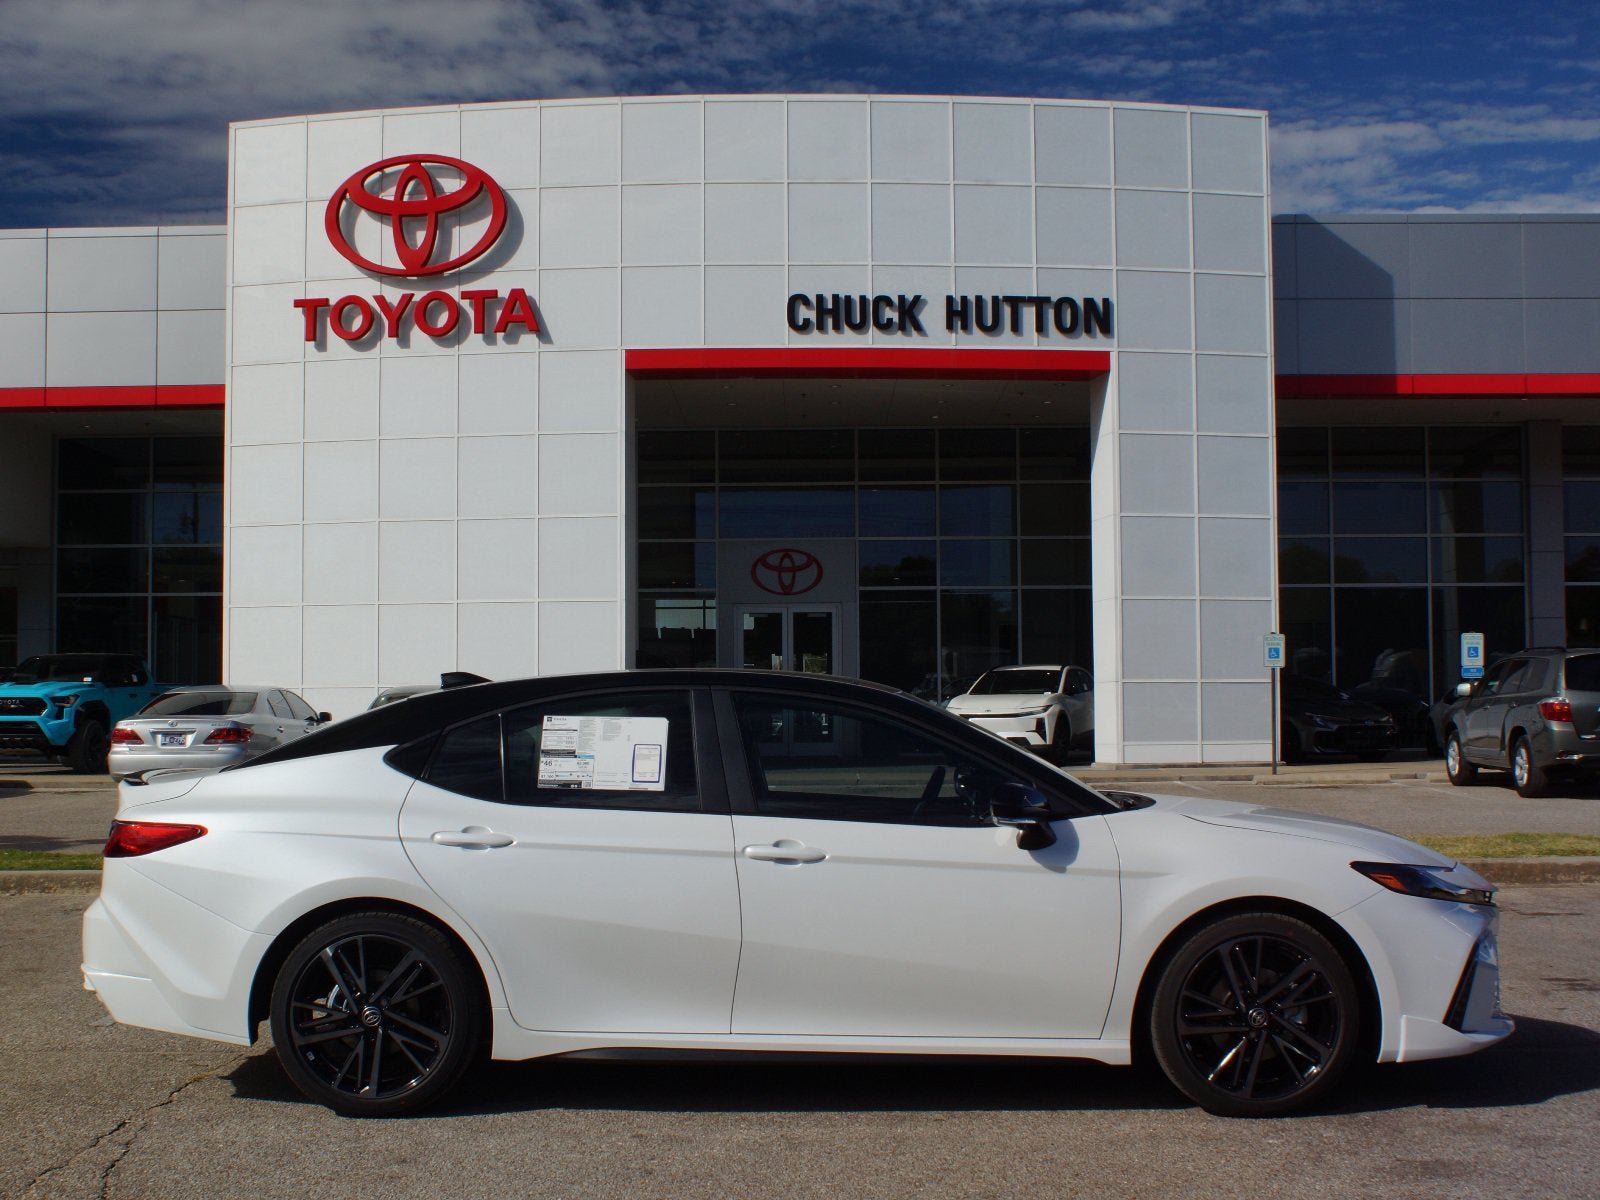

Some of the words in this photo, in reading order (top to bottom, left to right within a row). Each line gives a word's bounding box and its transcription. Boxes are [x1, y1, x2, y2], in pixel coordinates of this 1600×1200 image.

[293, 288, 540, 341] TOYOTA
[787, 293, 924, 332] CHUCK
[945, 295, 1112, 335] HUTTON
